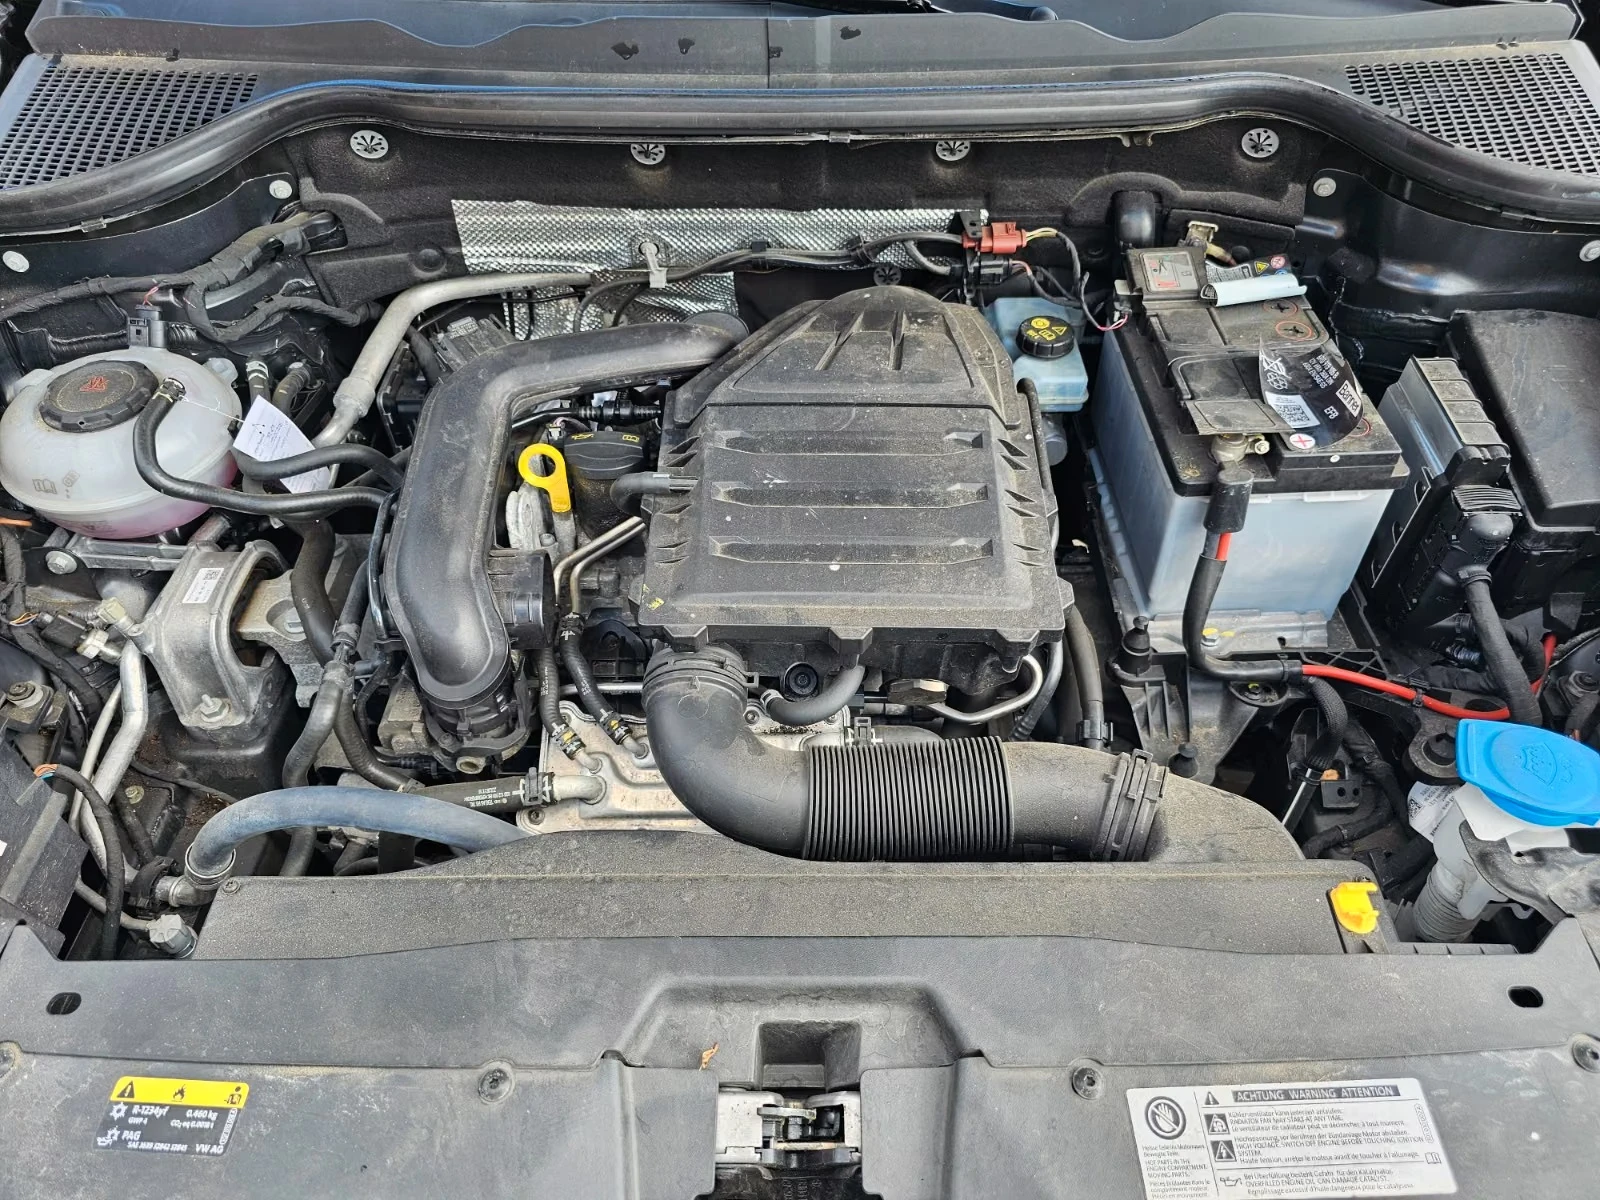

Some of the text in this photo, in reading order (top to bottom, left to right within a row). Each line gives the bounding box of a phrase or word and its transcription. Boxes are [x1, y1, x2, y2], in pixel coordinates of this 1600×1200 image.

[1338, 383, 1360, 411] Banner
[1324, 405, 1340, 420] EFB
[1236, 1086, 1394, 1101] ACHTUNG WARNING ATTENTION
[132, 1104, 170, 1118] R-1234yf
[208, 1110, 218, 1121] kg
[122, 1130, 142, 1141] PAG
[195, 1144, 224, 1154] VW AG
